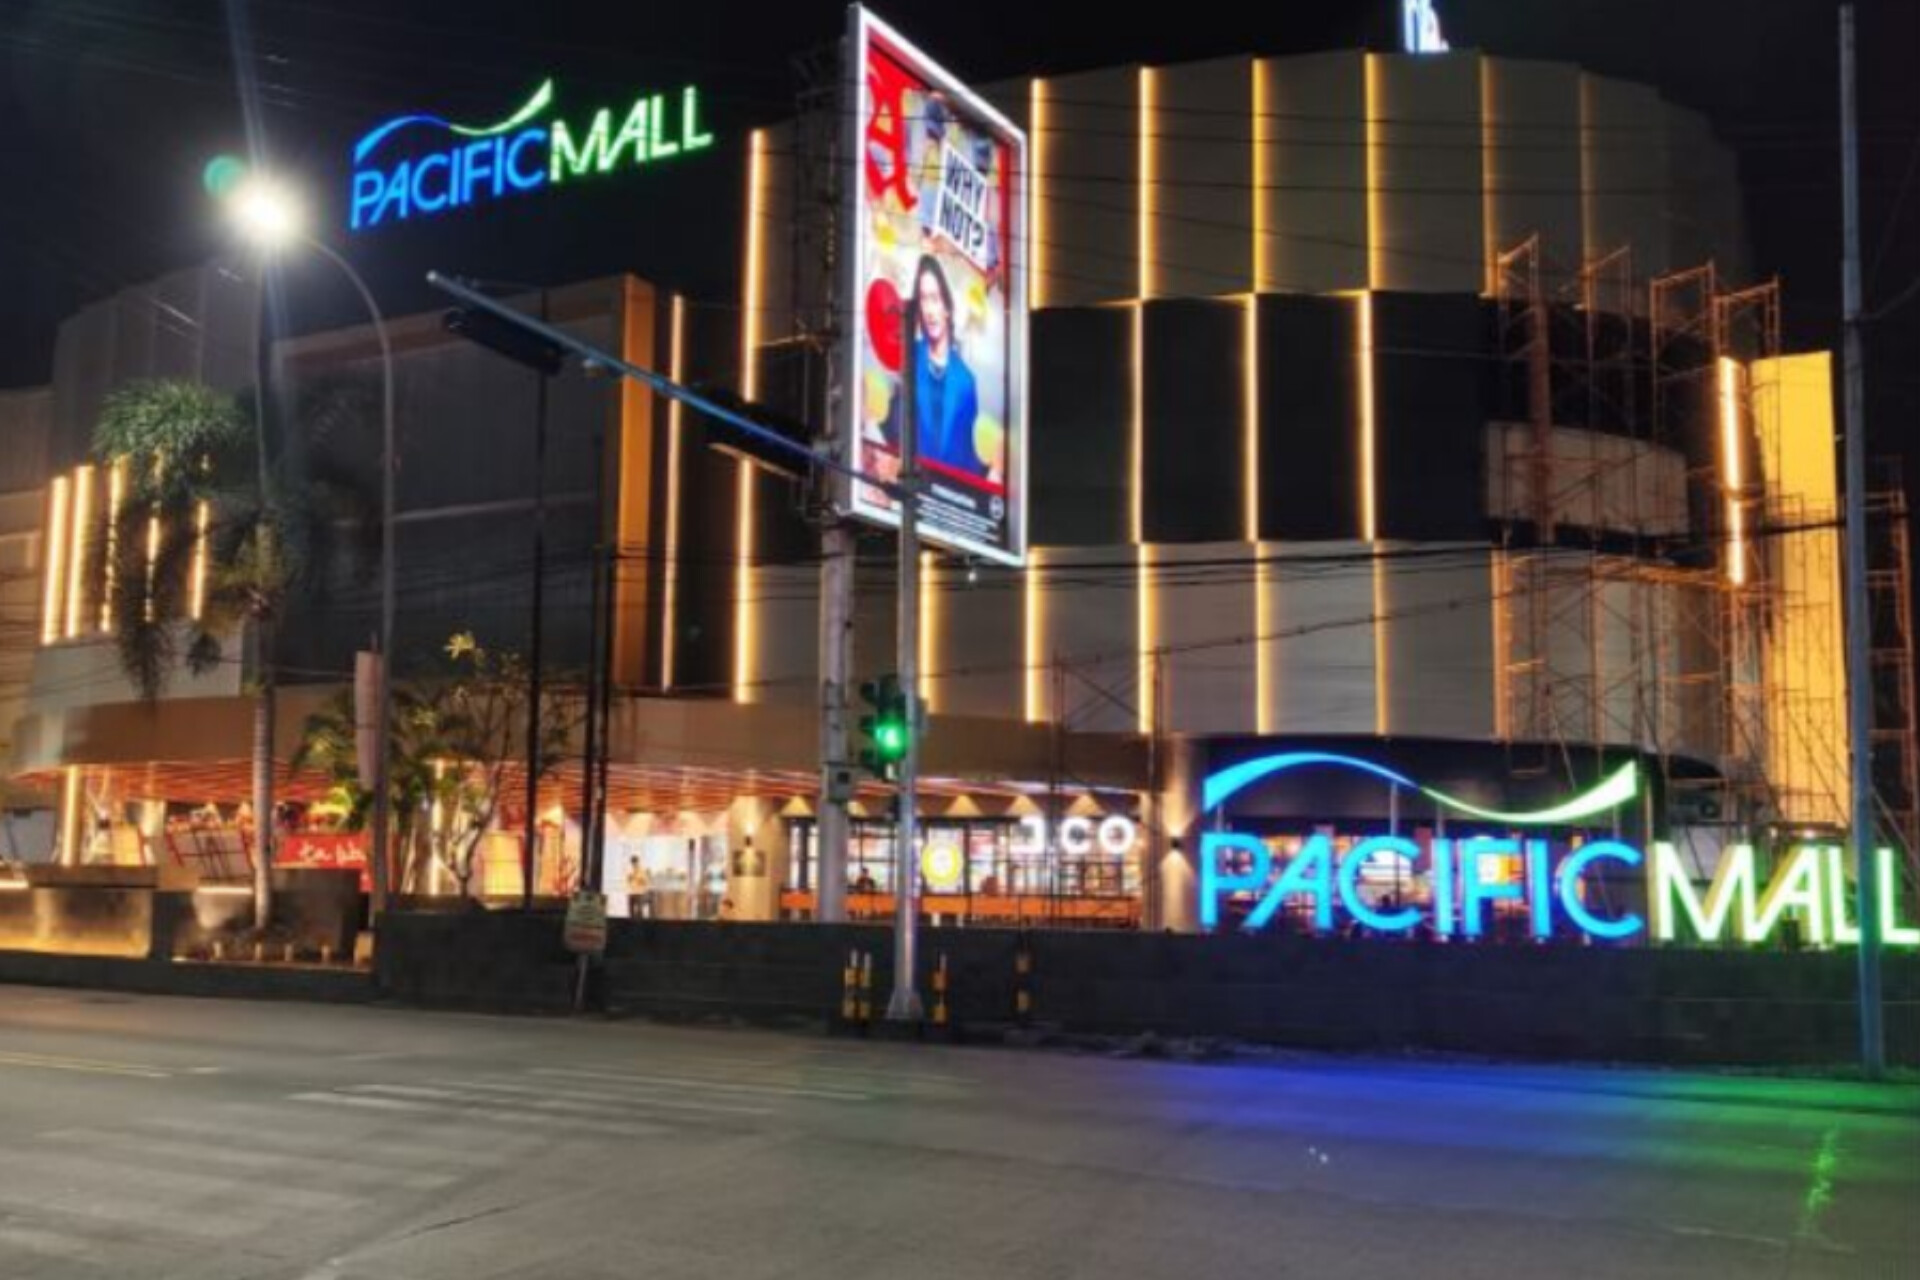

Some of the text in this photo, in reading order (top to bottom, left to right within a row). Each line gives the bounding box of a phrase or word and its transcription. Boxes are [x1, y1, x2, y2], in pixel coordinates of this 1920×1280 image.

[351, 85, 713, 229] PACIFIC MALL
[945, 147, 985, 214] WHY
[939, 188, 985, 257] NOT?
[1010, 815, 1135, 854] J.CO
[1200, 833, 1920, 945] PACIFIC MALL
